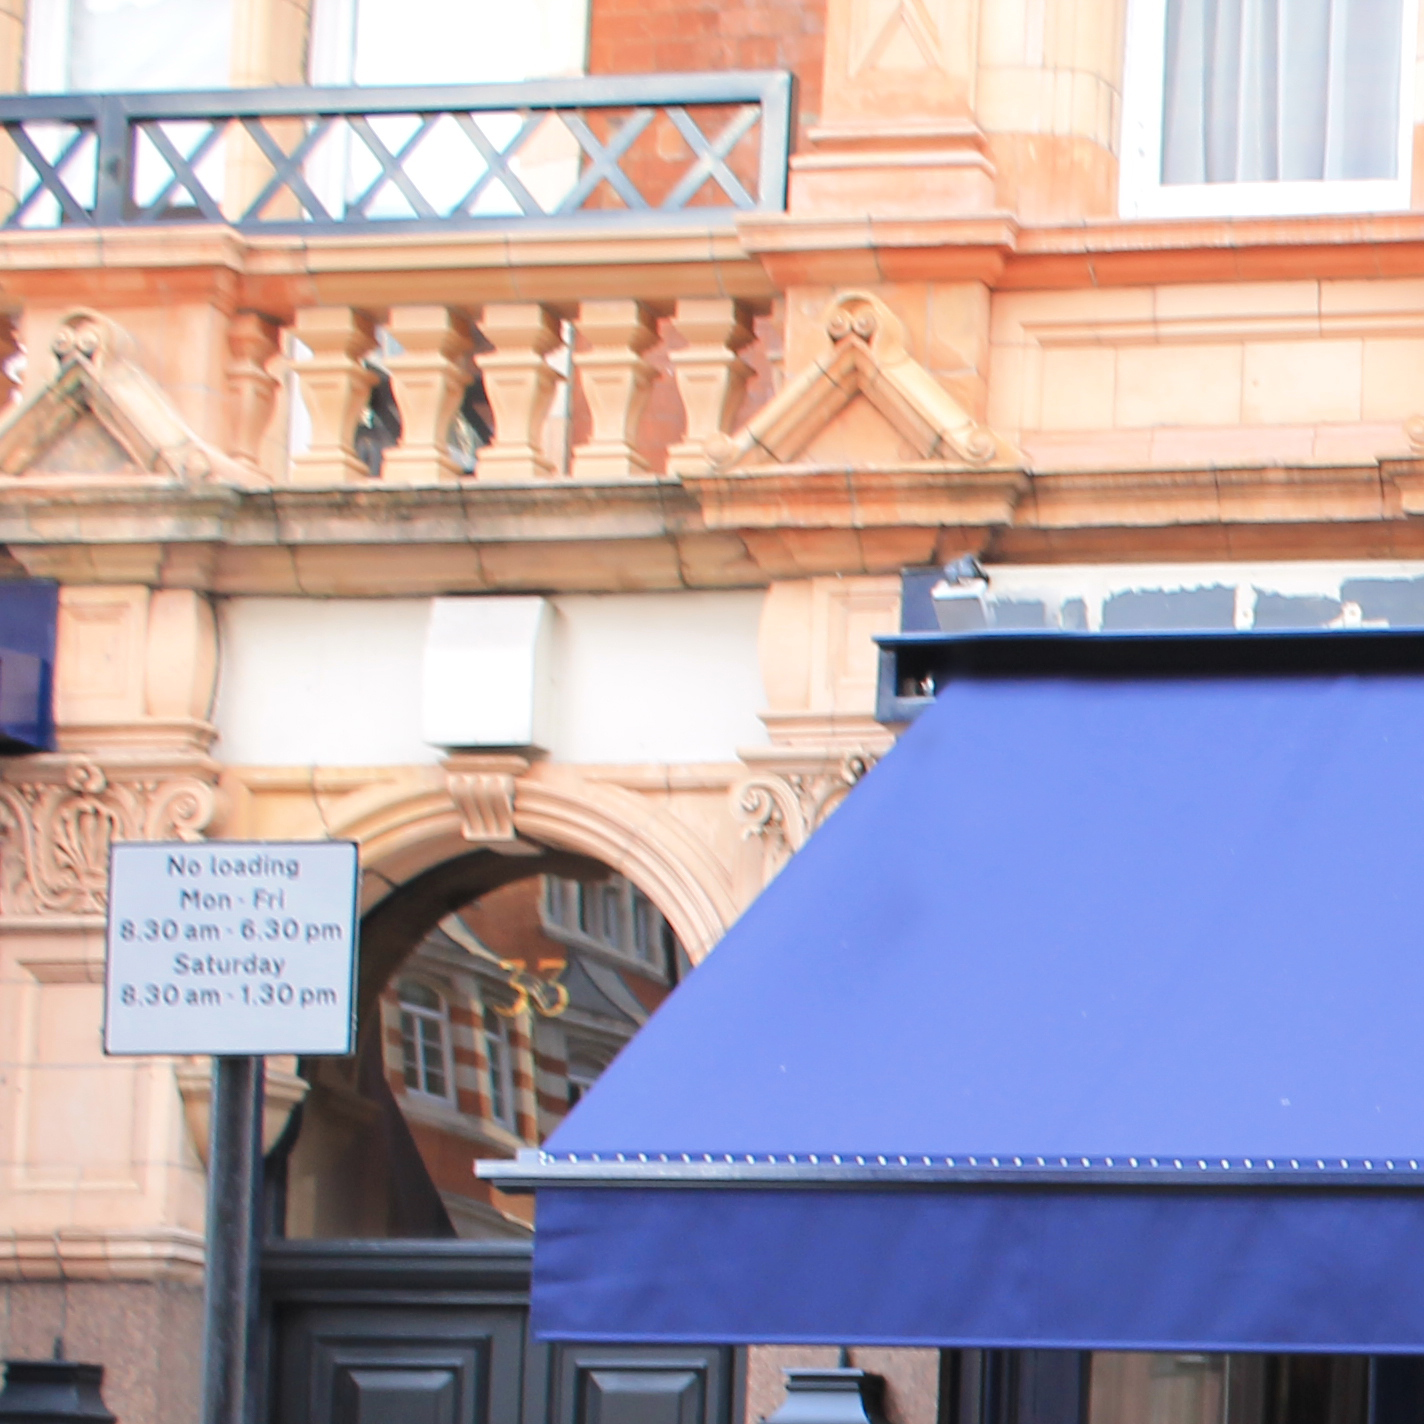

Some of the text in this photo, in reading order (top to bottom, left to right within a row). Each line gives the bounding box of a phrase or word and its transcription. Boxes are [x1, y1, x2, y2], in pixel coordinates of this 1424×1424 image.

[166, 854, 300, 879] No loading
[179, 888, 232, 911] Mon
[252, 888, 286, 910] Fri
[118, 917, 180, 942] 8.30
[183, 923, 221, 941] am
[239, 917, 300, 941] 6.30
[304, 922, 343, 944] pm
[172, 952, 286, 978] Saturday
[119, 982, 180, 1007] 8.30
[183, 988, 221, 1006] am
[240, 982, 295, 1006] 1.30
[298, 987, 338, 1009] pm
[493, 957, 569, 1017] 33
